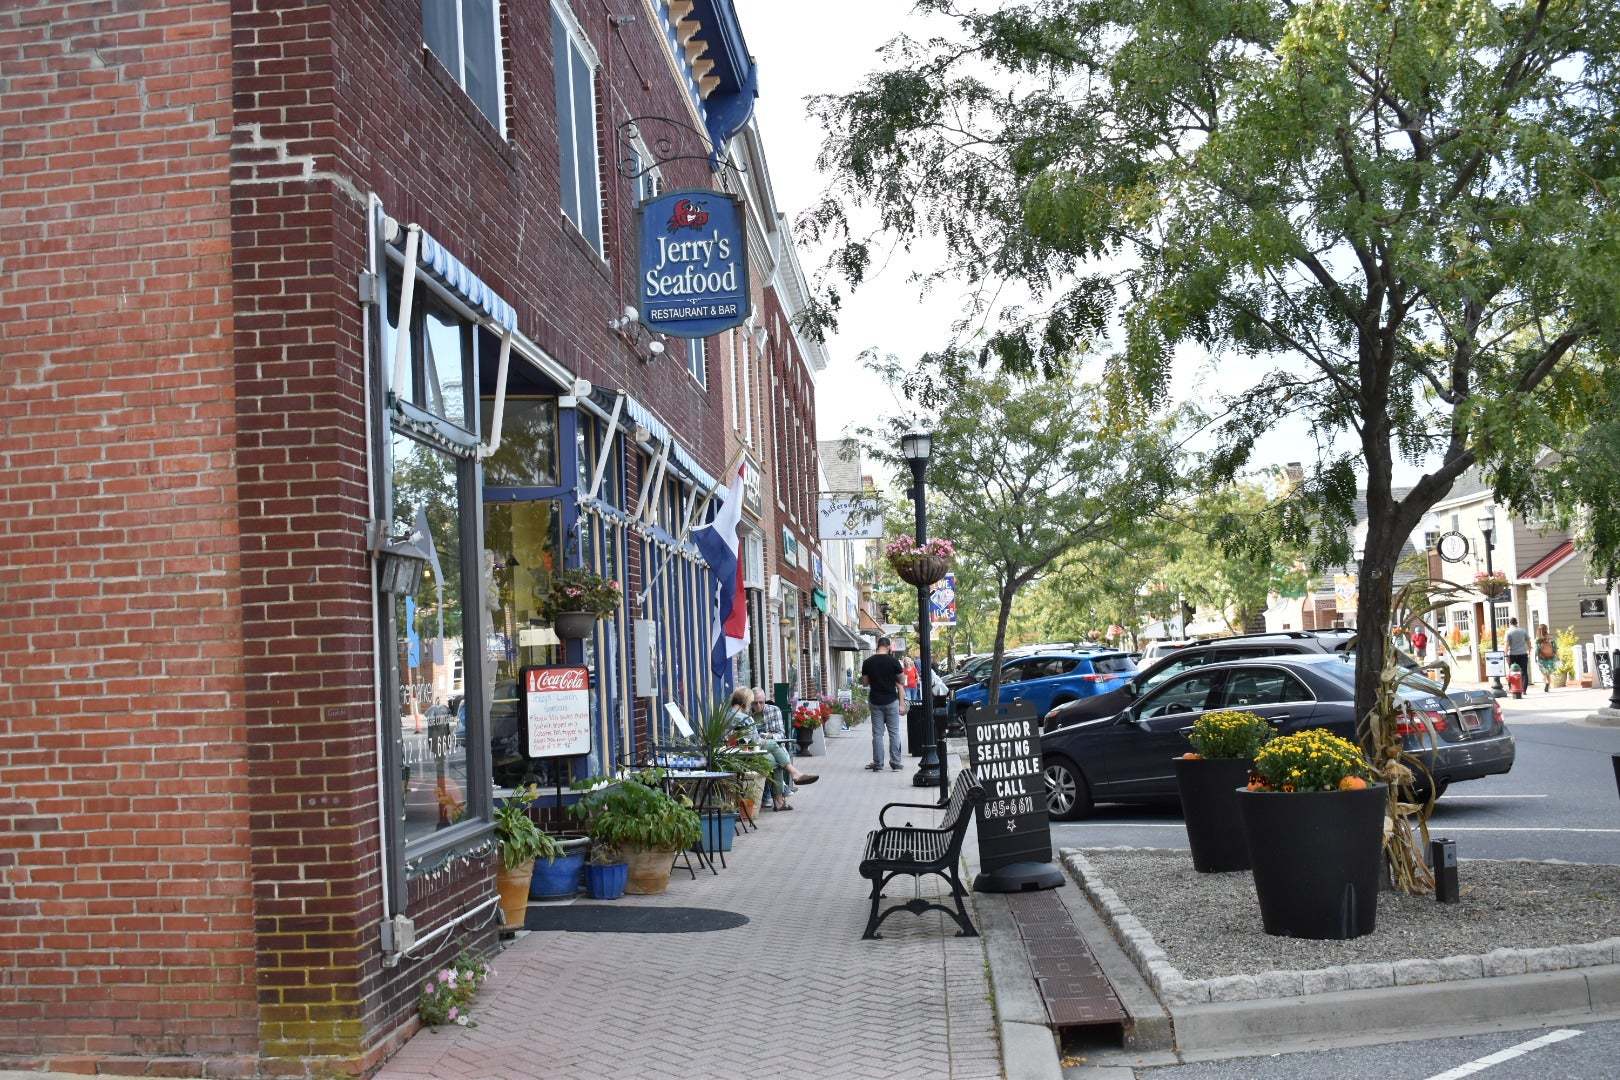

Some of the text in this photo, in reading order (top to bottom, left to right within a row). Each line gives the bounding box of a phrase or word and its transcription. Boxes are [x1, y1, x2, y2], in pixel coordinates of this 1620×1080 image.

[656, 230, 730, 270] Jerry's
[646, 262, 737, 297] Seafood
[651, 304, 737, 320] RESTAURANT & BAR
[976, 721, 1031, 742] OUTDOOR
[977, 740, 1030, 761] SEATING
[976, 757, 1040, 781] AVAILABLE
[996, 779, 1026, 798] CALL
